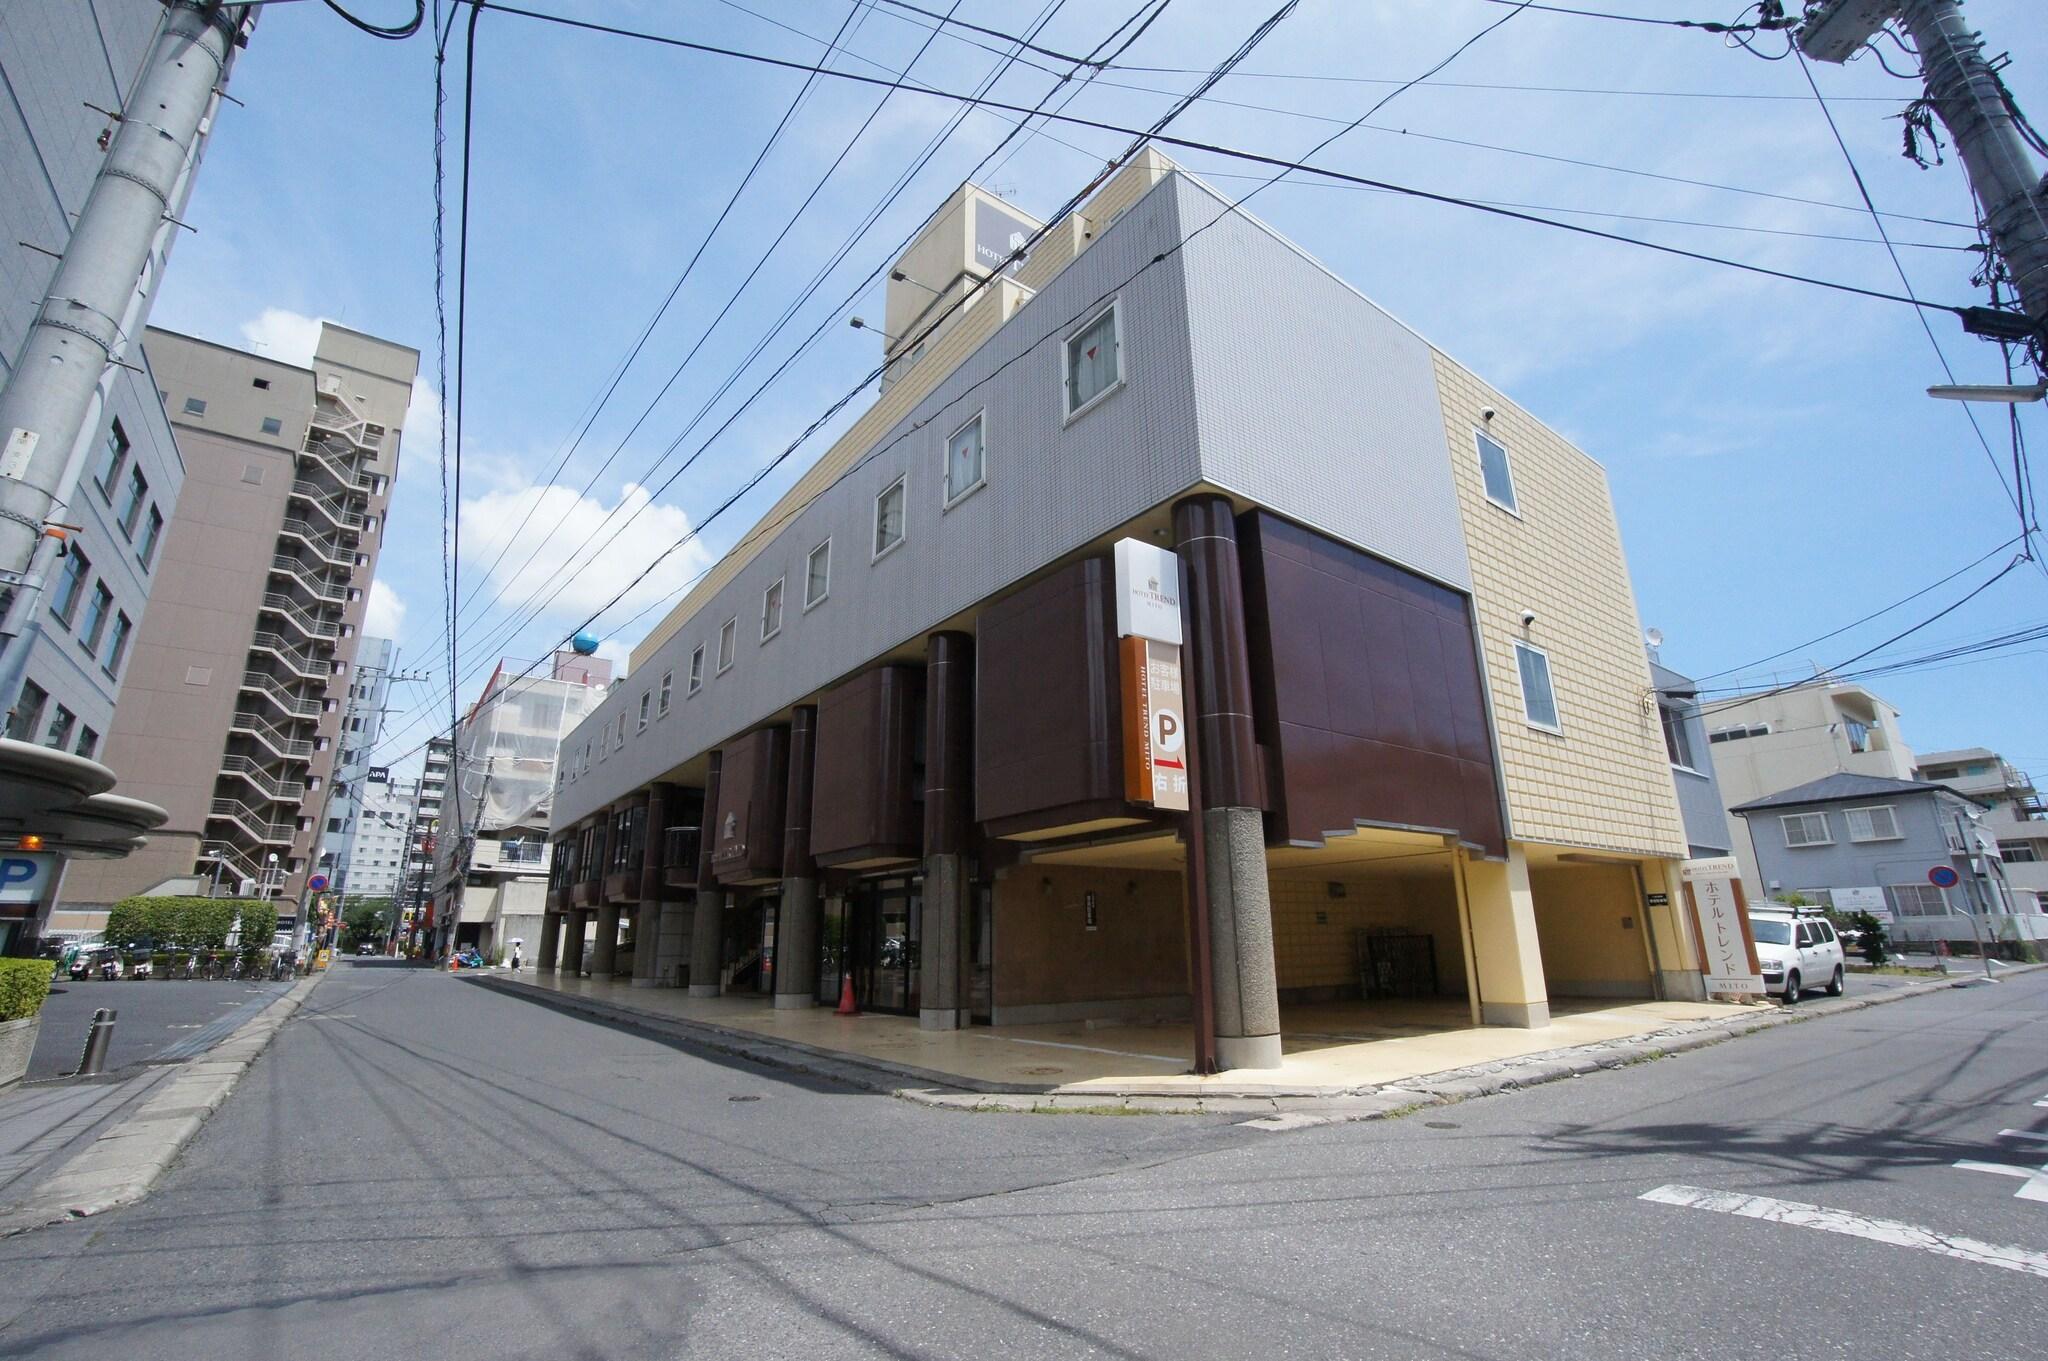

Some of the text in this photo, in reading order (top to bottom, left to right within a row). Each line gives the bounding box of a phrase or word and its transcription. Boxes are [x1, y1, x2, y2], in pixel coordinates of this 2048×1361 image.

[1150, 592, 1176, 606] TREND
[1159, 714, 1177, 745] P
[369, 770, 386, 779] APA
[1155, 772, 1187, 794] 右折
[0, 859, 37, 893] P
[1708, 863, 1735, 871] TREND
[1706, 881, 1736, 975] ホテルトレンド
